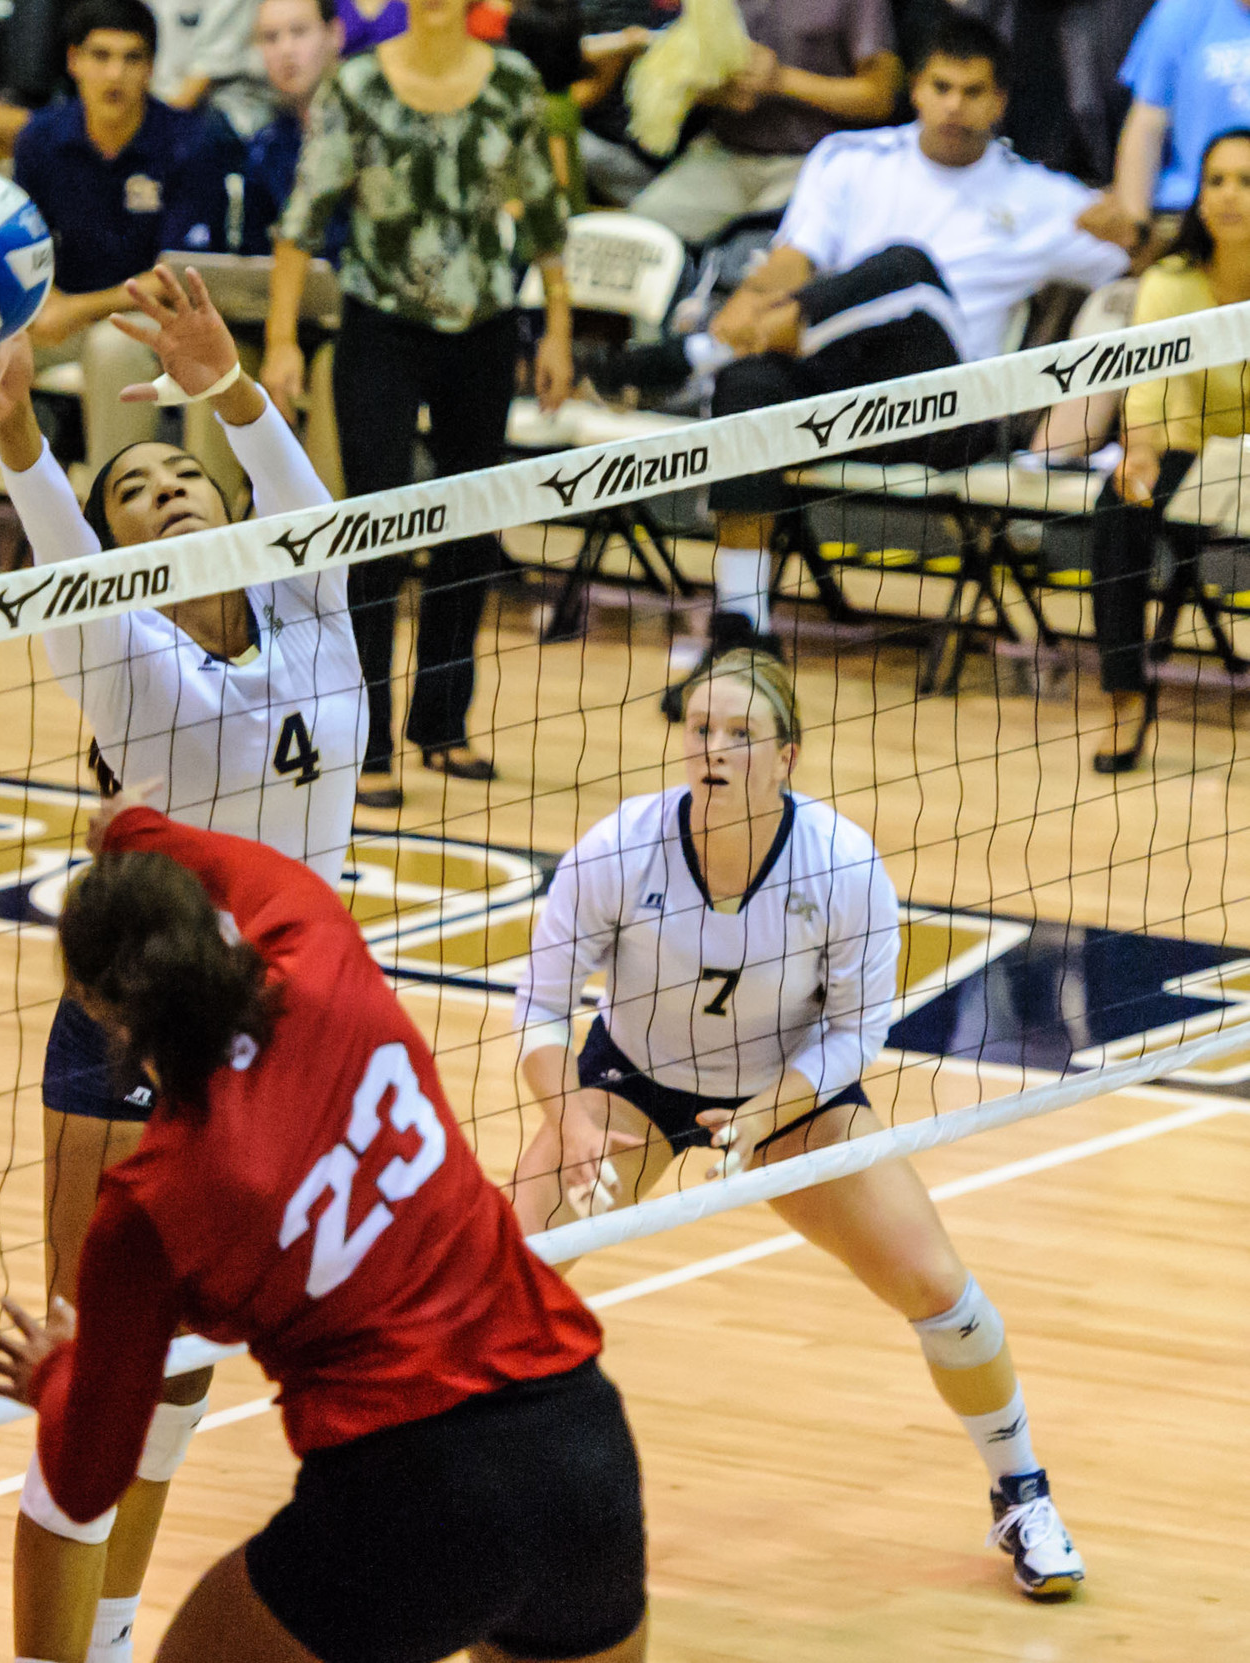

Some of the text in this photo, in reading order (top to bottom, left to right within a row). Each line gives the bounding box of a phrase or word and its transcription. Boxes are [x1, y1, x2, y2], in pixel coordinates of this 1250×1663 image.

[272, 711, 323, 788] 4
[701, 967, 743, 1017] 7
[278, 1041, 447, 1299] 23
